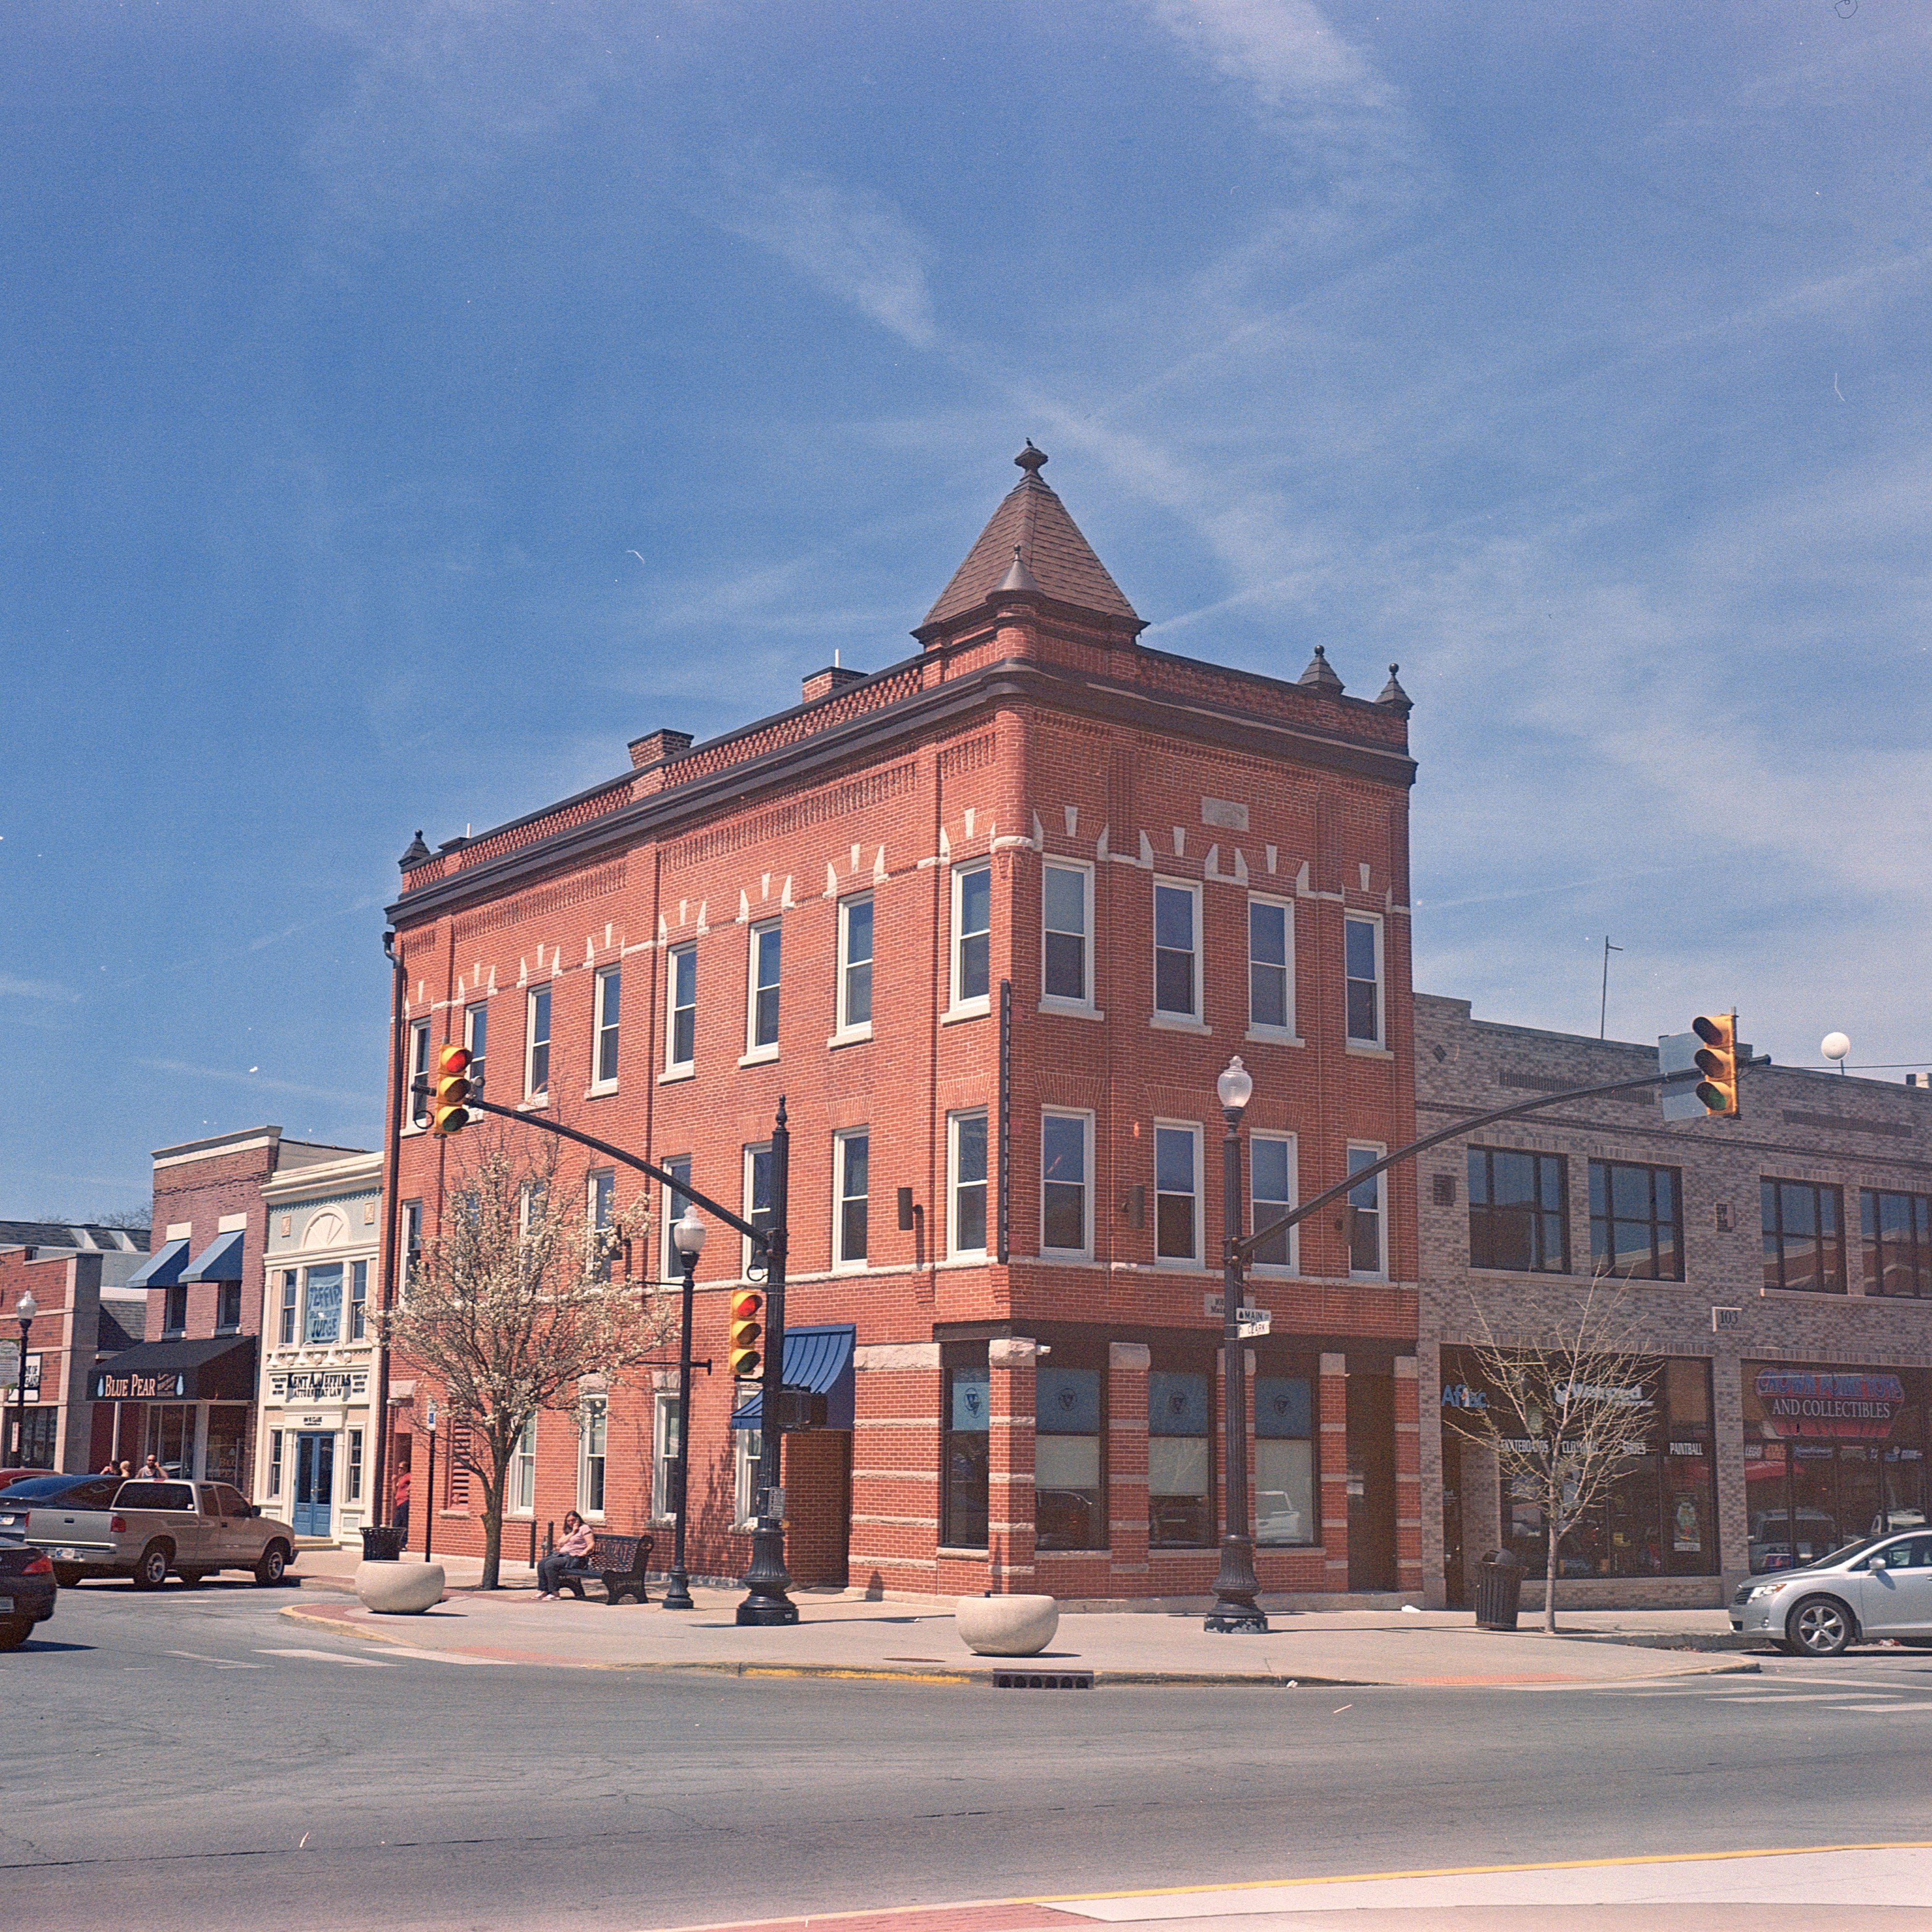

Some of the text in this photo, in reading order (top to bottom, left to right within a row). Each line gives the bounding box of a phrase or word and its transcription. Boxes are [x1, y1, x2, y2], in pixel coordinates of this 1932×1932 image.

[1245, 1311, 1262, 1321] MAIN
[1720, 1310, 1738, 1324] 103
[311, 1319, 338, 1337] JUDGE
[1248, 1324, 1265, 1334] CLARK
[105, 1375, 128, 1397] BLUE
[130, 1374, 156, 1396] PEAR
[287, 1373, 308, 1388] KENT
[1758, 1370, 1903, 1399] CROWN POINT TOYS
[329, 1388, 342, 1397] LAW
[1773, 1399, 1890, 1418] AND COLLECTIBLES
[1669, 1442, 1704, 1455] PAINTBALL
